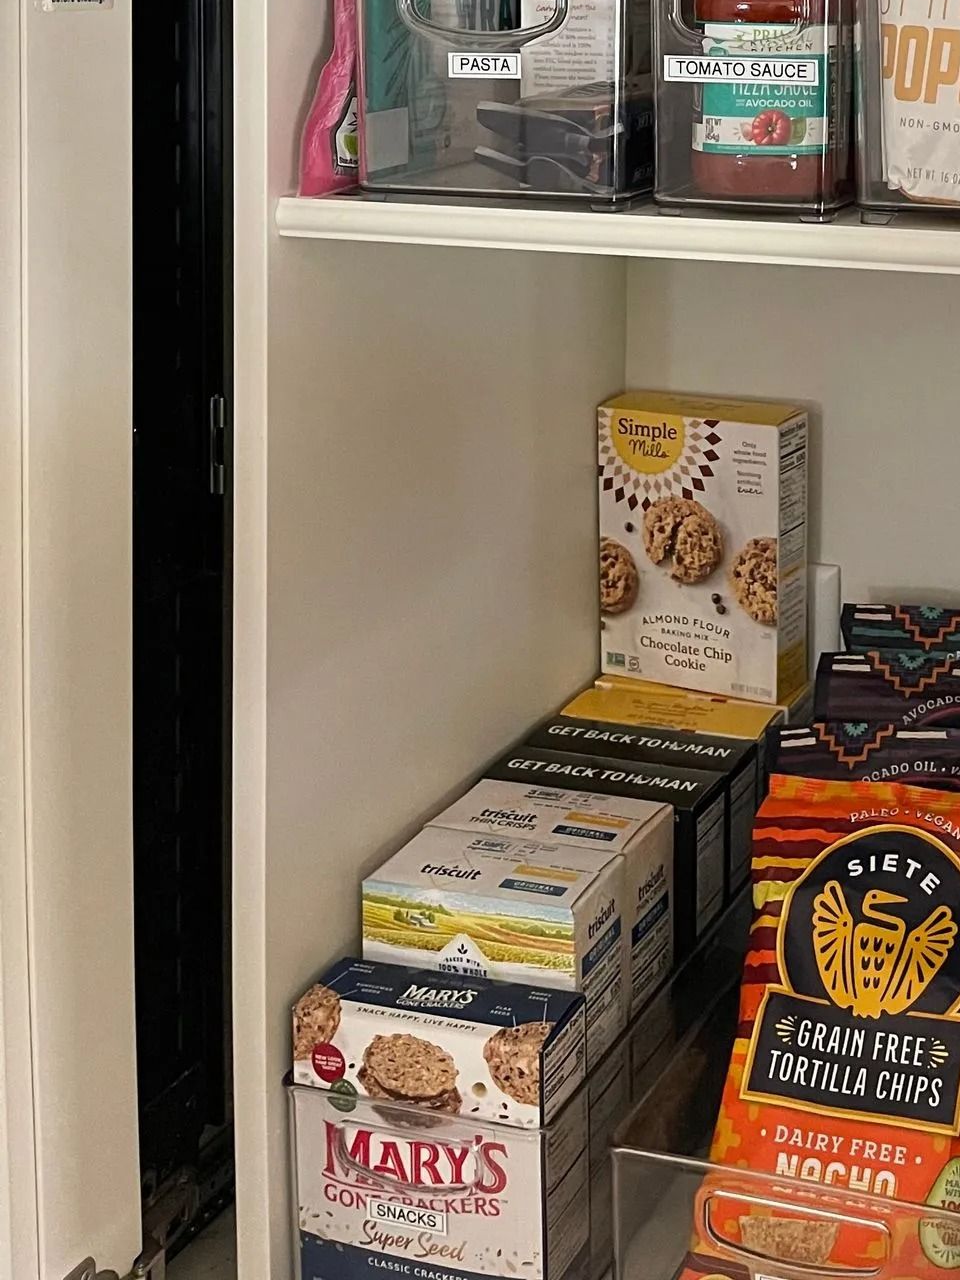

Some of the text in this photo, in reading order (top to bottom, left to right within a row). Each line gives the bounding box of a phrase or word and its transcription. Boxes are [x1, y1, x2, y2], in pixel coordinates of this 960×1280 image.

[460, 58, 511, 72] PASTA
[676, 60, 808, 78] TOMATO SAUCE
[745, 99, 813, 108] AVOCADO OIL
[900, 117, 960, 134] NON-GMO
[940, 171, 949, 183] 16
[618, 418, 677, 442] Simple
[629, 438, 669, 458] Mills
[642, 615, 730, 639] ALMOND FLOUR
[661, 628, 692, 638] BAKING
[640, 635, 732, 663] Chocolate Chip
[664, 654, 706, 671] Cookie
[548, 725, 662, 748] GET BACK TO
[507, 758, 624, 781] GET BACK TO
[914, 761, 937, 772] OIL
[480, 808, 538, 823] triscuit
[850, 806, 899, 823] PALEO
[497, 819, 537, 831] CRISPS
[420, 863, 482, 880] triscuit
[847, 854, 940, 895] SIETE
[588, 898, 615, 939] triscuit
[402, 985, 478, 1004] MARY'S
[421, 1001, 465, 1010] CRACKERS
[357, 1007, 478, 1032] SNACK LIVE HAPPY
[797, 1020, 926, 1067] GRAIN FREE
[768, 1050, 943, 1108] TORTILLA CHIPS
[774, 1125, 908, 1165] DAIRY FREE
[322, 1120, 508, 1194] MARY'S
[775, 1152, 898, 1198] NACHO
[377, 1204, 436, 1228] SNACKS
[360, 1220, 467, 1261] Super Seed
[368, 1257, 410, 1274] CLASSIC
